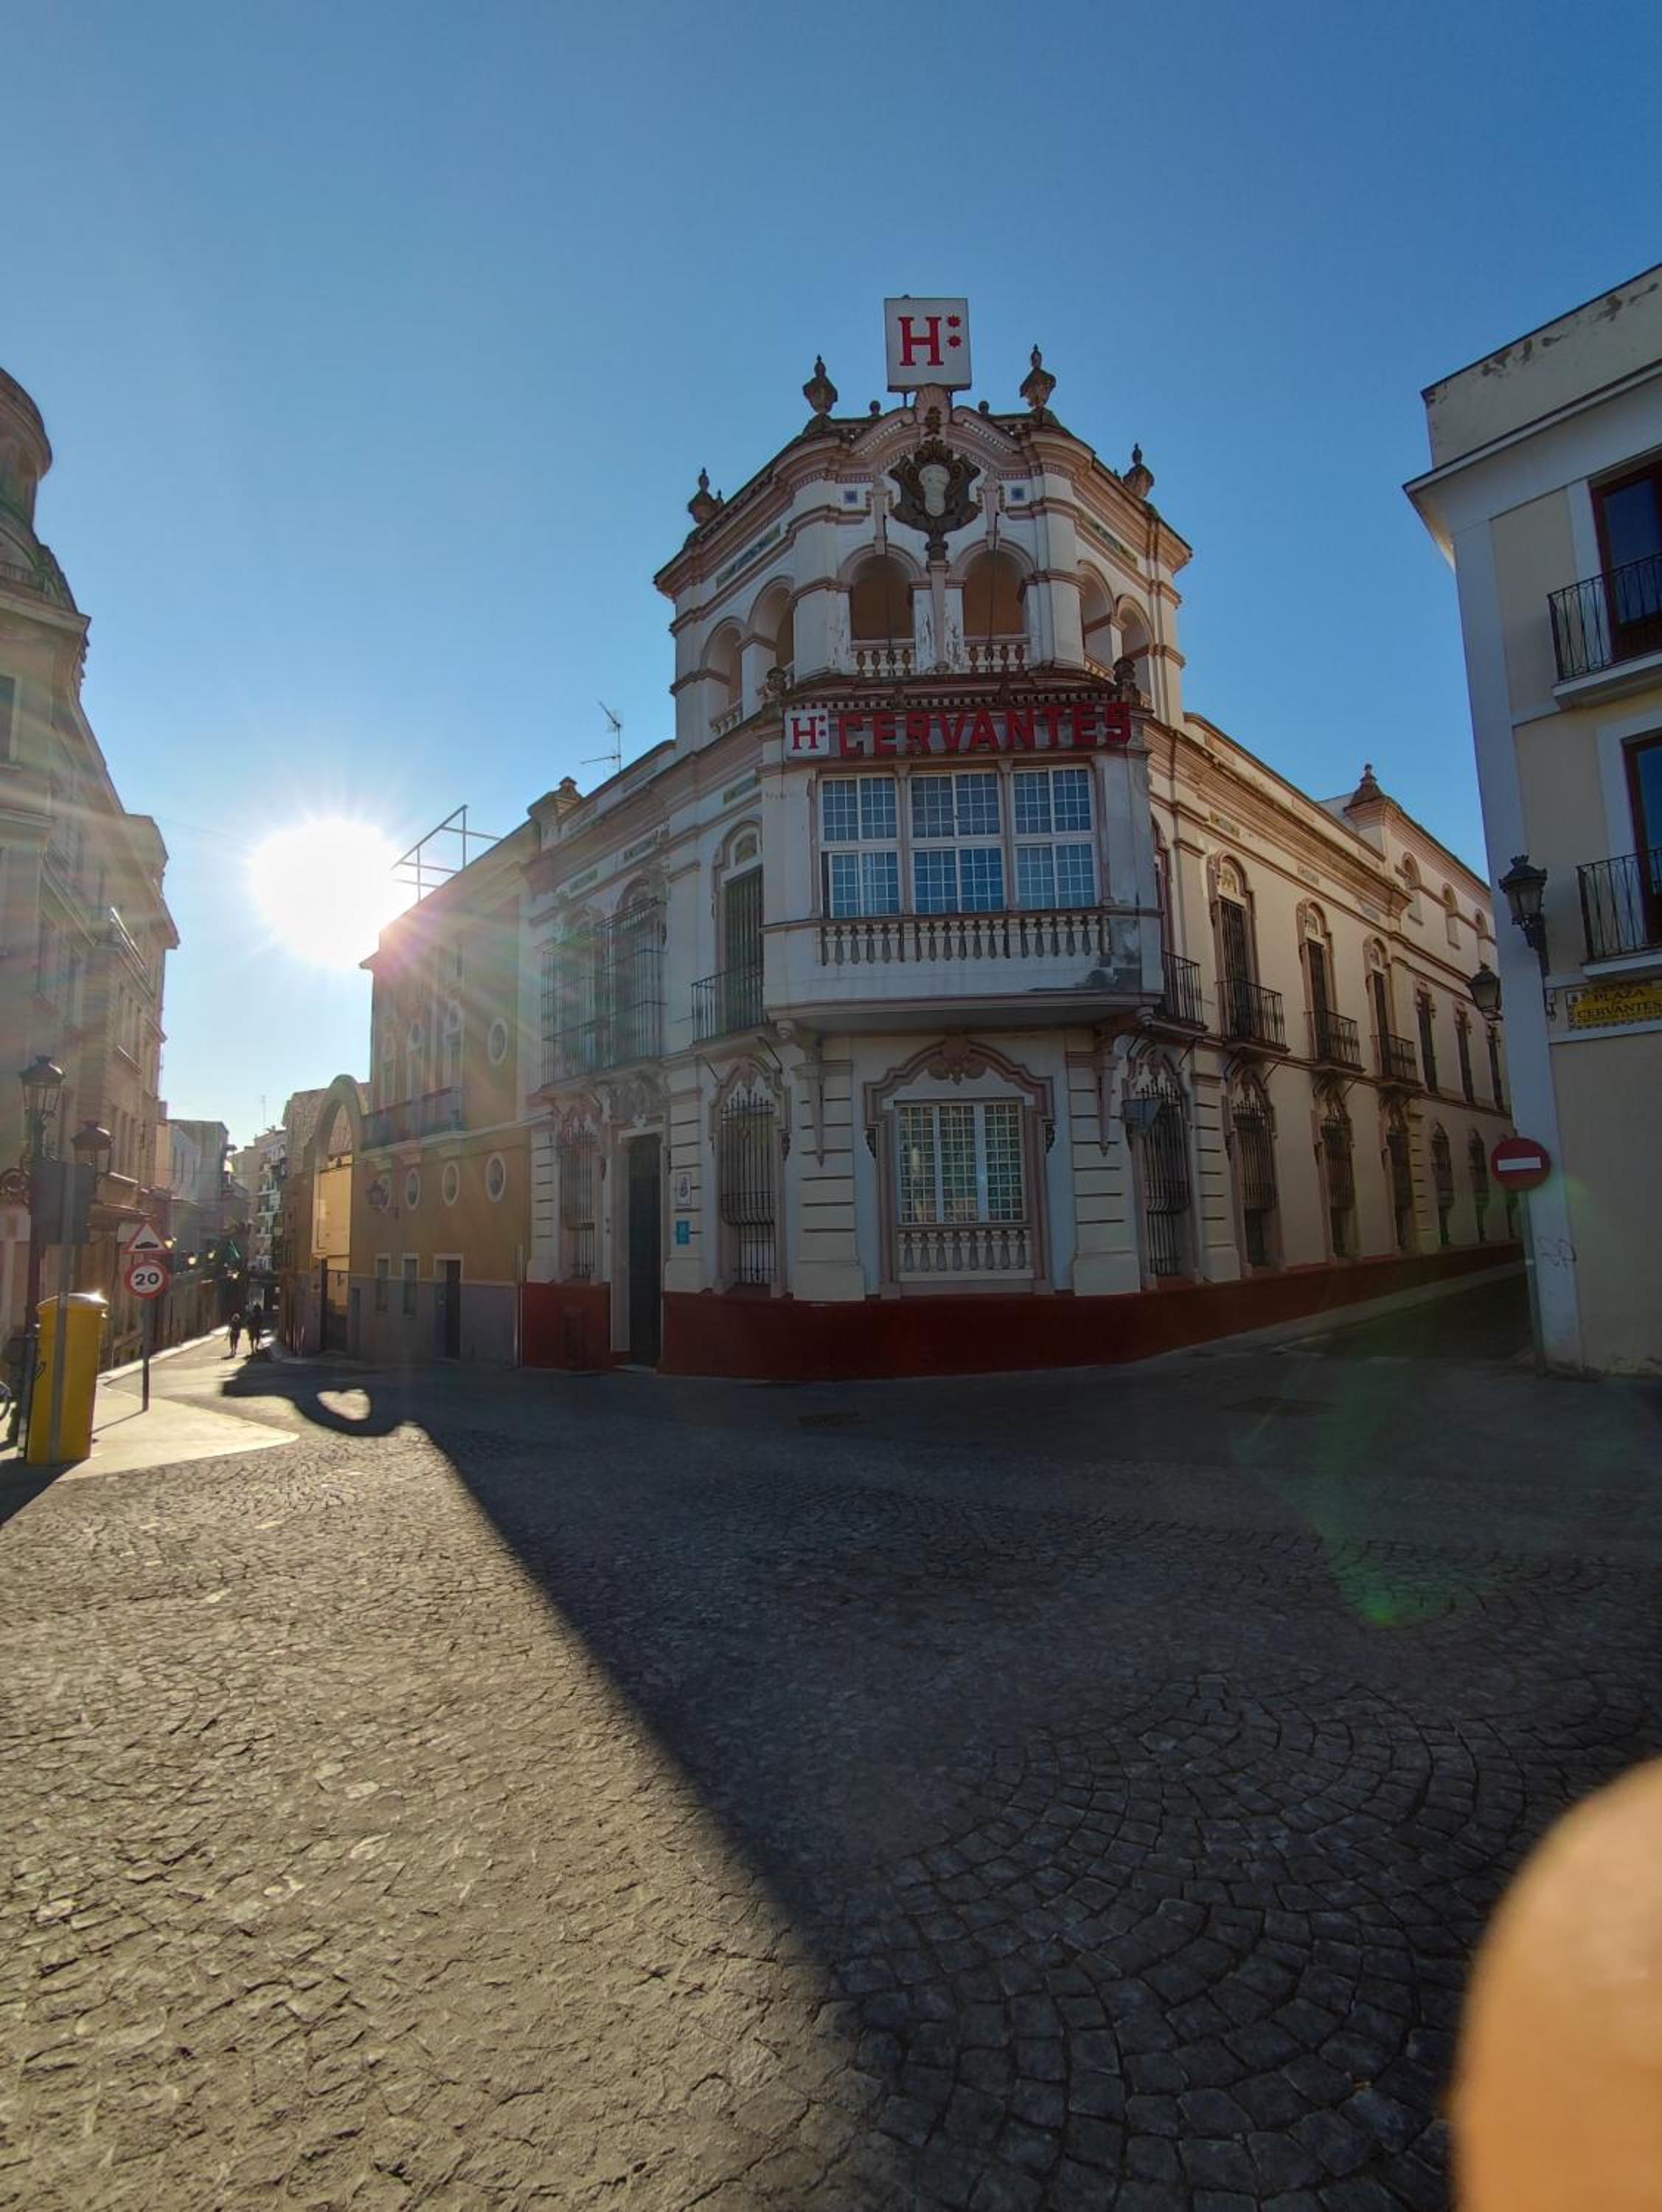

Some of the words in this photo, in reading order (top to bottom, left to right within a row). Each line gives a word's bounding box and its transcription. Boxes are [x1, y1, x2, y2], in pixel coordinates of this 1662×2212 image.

[897, 316, 945, 366] H
[791, 717, 820, 750] H
[838, 701, 1133, 756] CERVANTES
[135, 1272, 159, 1286] 20
